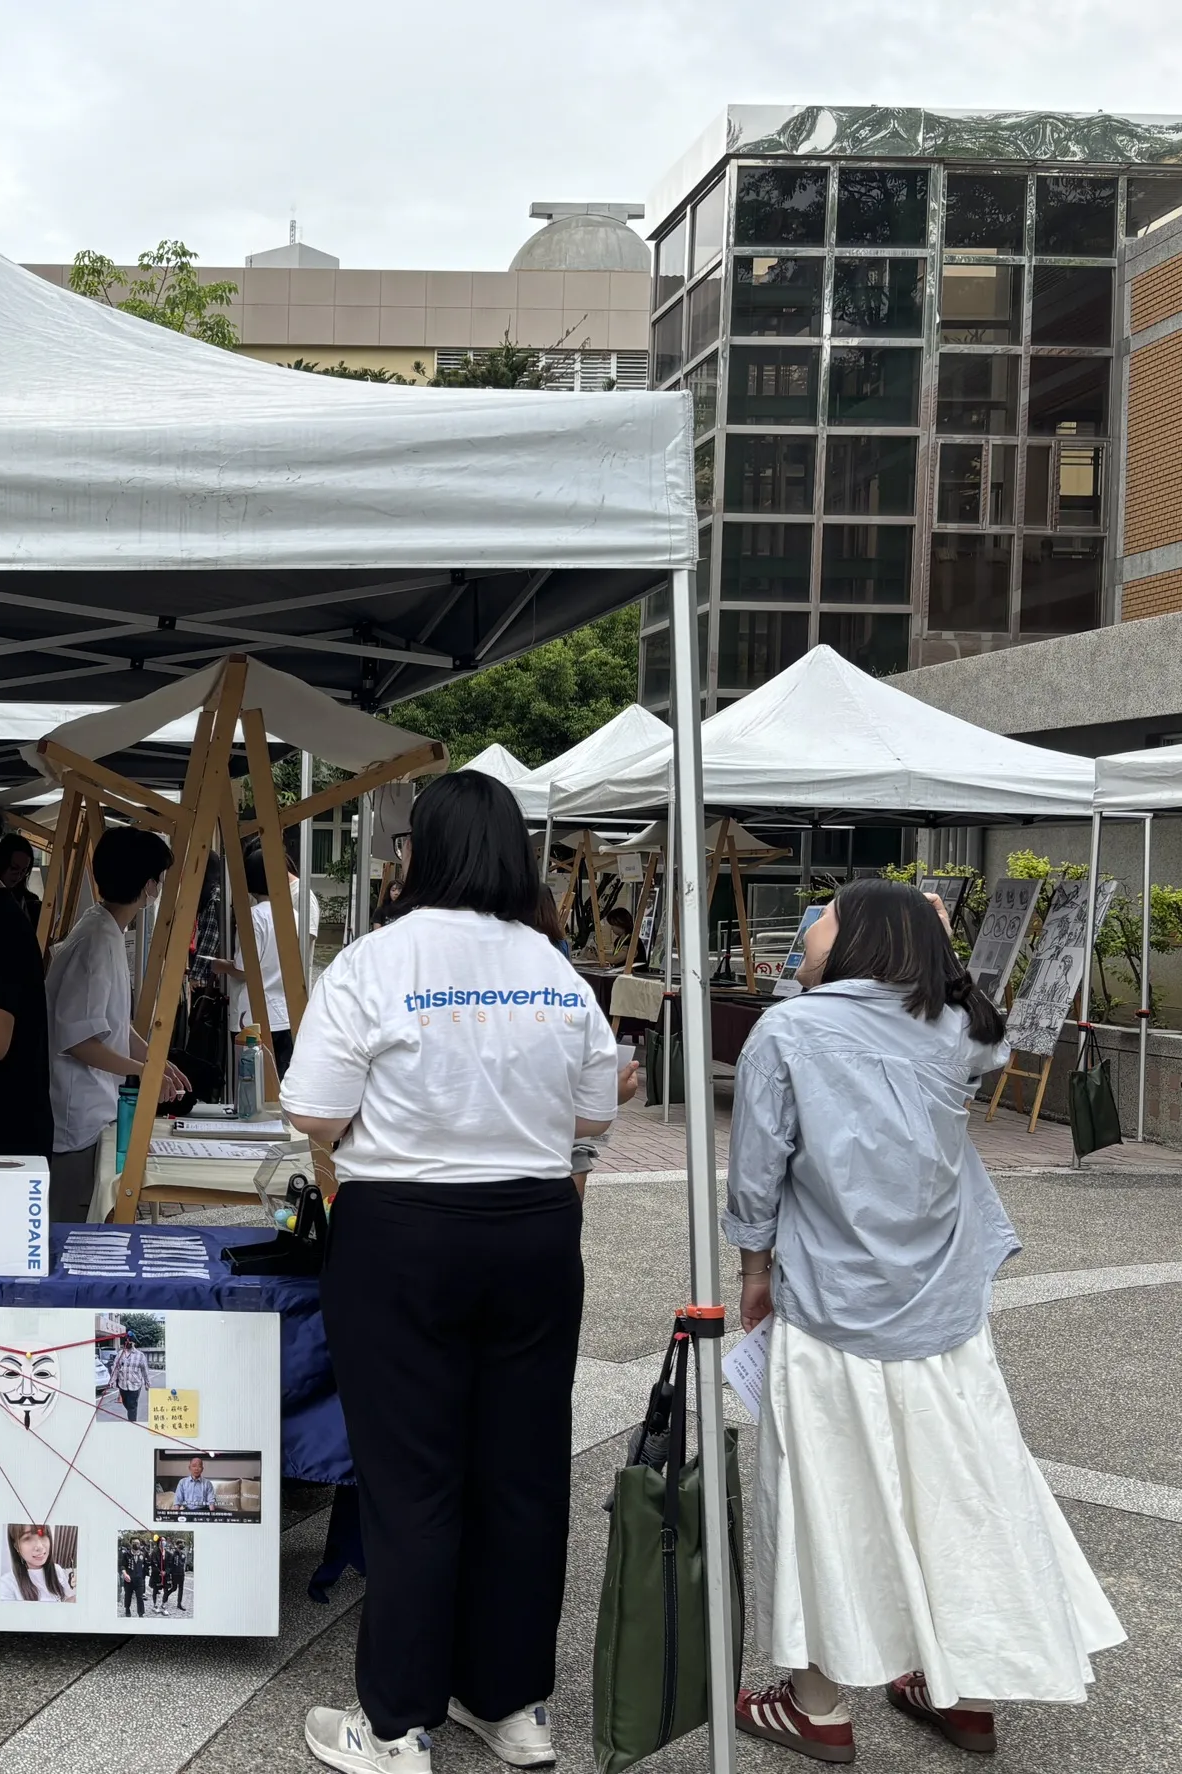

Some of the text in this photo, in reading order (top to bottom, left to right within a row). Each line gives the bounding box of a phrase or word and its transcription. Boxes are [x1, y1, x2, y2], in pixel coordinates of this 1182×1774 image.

[420, 1011, 574, 1027] DESIGN
[28, 1179, 42, 1270] MIOPANE
[346, 1727, 363, 1751] N
